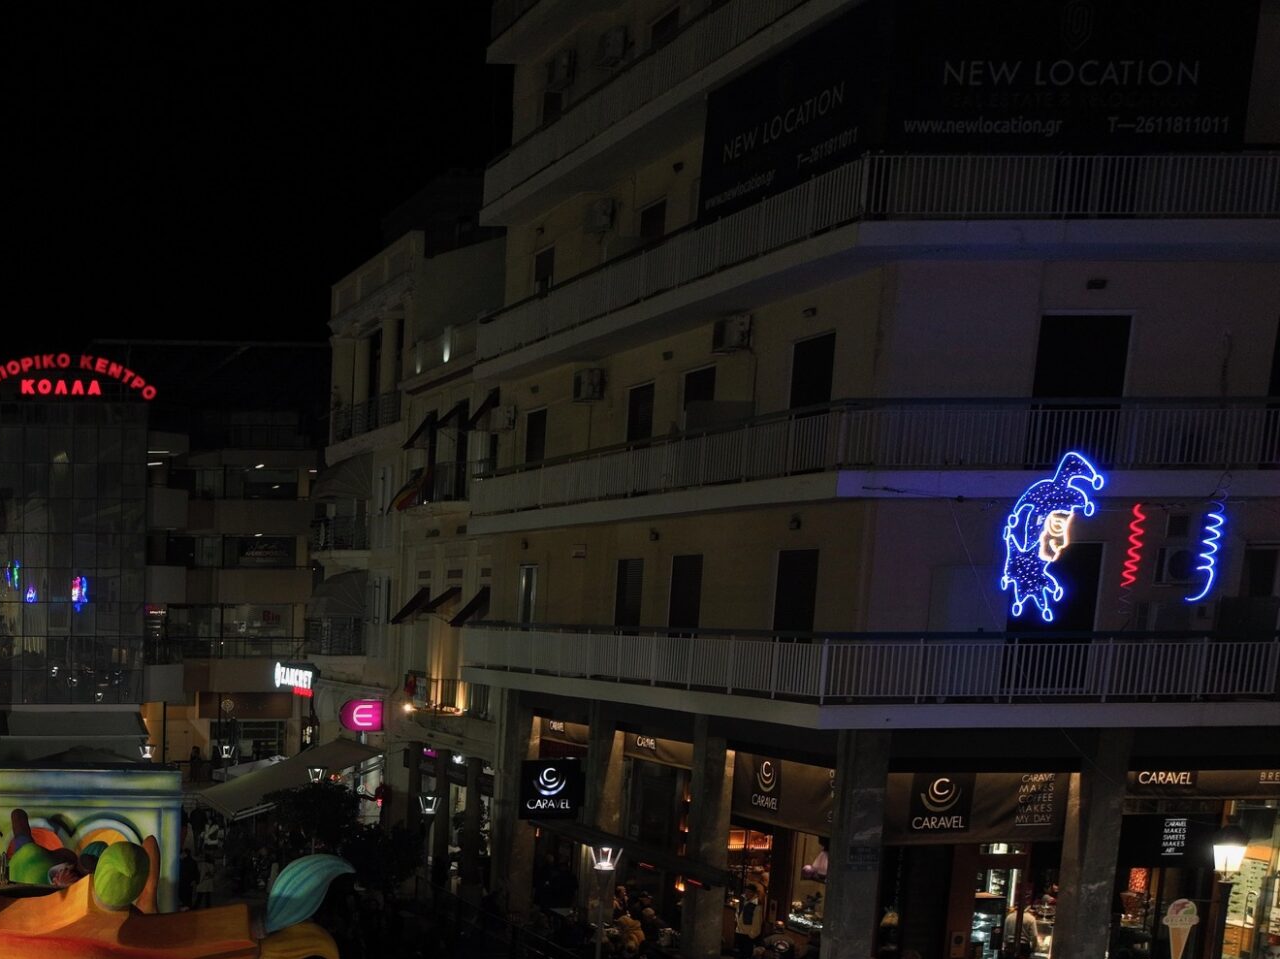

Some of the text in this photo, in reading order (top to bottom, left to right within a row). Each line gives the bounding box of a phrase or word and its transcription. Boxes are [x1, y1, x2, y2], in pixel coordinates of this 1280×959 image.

[943, 60, 1200, 86] NEW LOCATION
[722, 81, 846, 163] NEW LOCATION
[903, 116, 1063, 136] www.newlocation.gr
[80, 354, 157, 400] ΚΕΝΤΡΟ
[21, 379, 101, 395] ΚΟΛΛΑ
[1138, 771, 1193, 785] CARAVEL
[526, 798, 571, 810] CARAVEL
[751, 793, 778, 811] CARAVEL
[911, 816, 965, 830] CARAVEL
